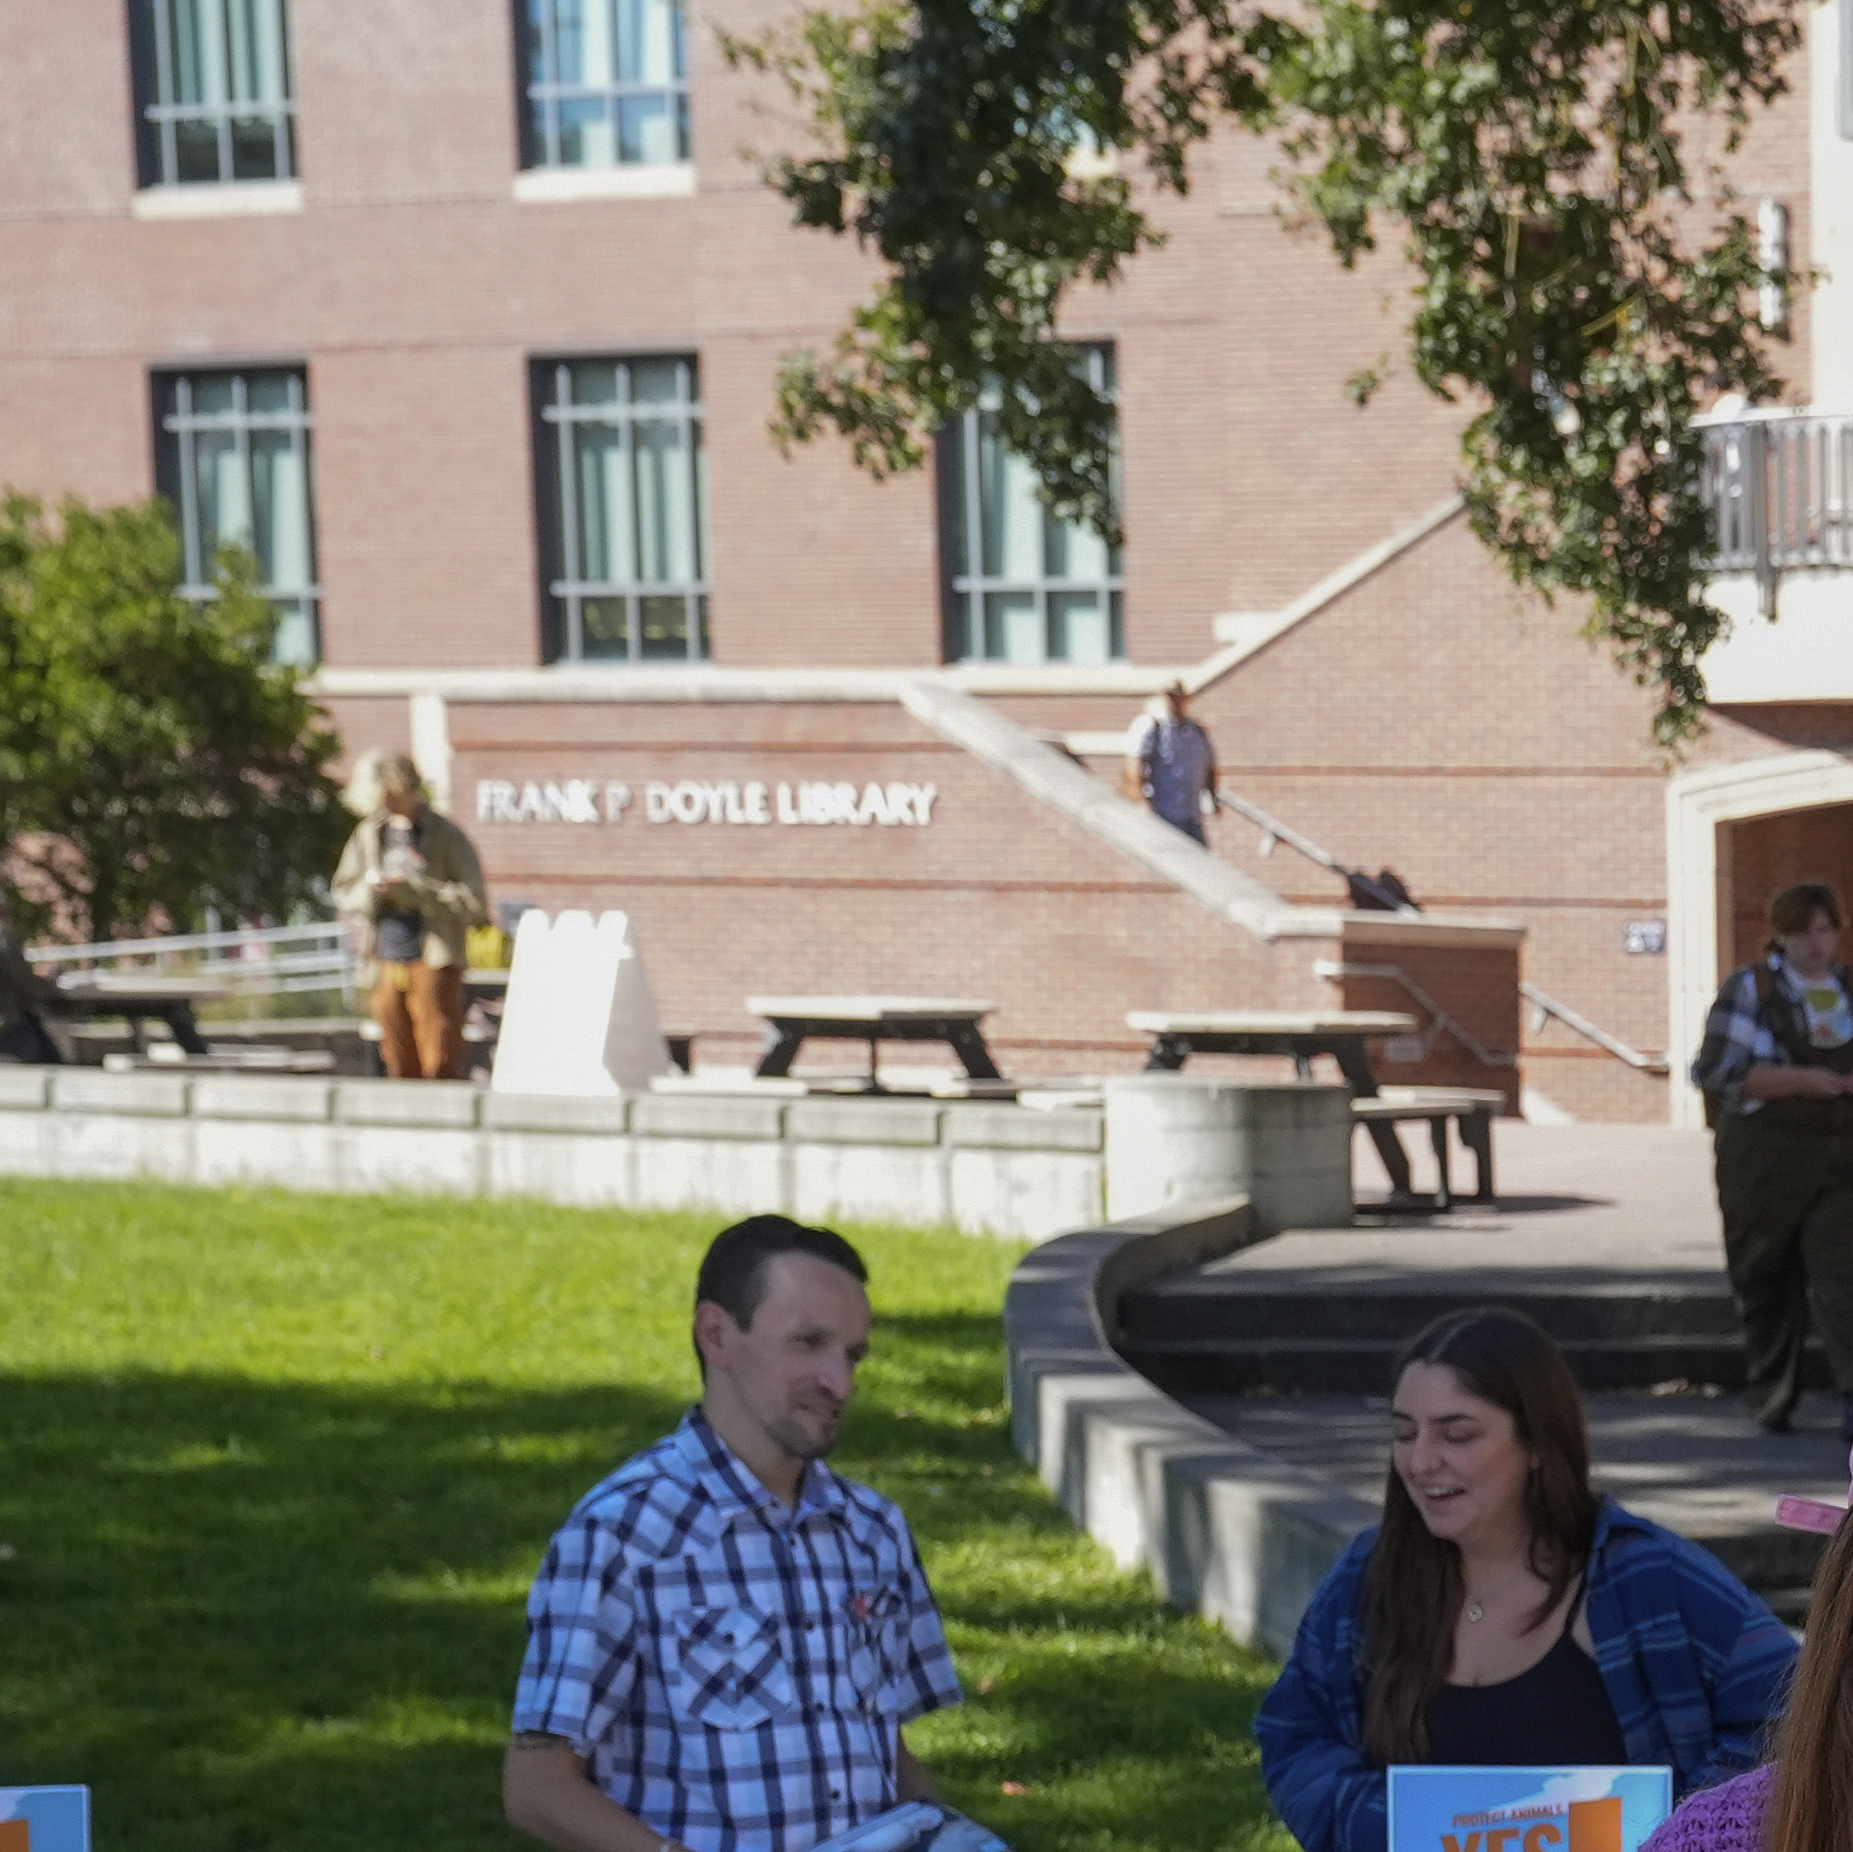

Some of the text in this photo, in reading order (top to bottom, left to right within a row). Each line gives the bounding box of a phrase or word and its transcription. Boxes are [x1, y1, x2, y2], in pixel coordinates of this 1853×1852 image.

[477, 779, 937, 826] FRANK P DOYLE LIBRARY
